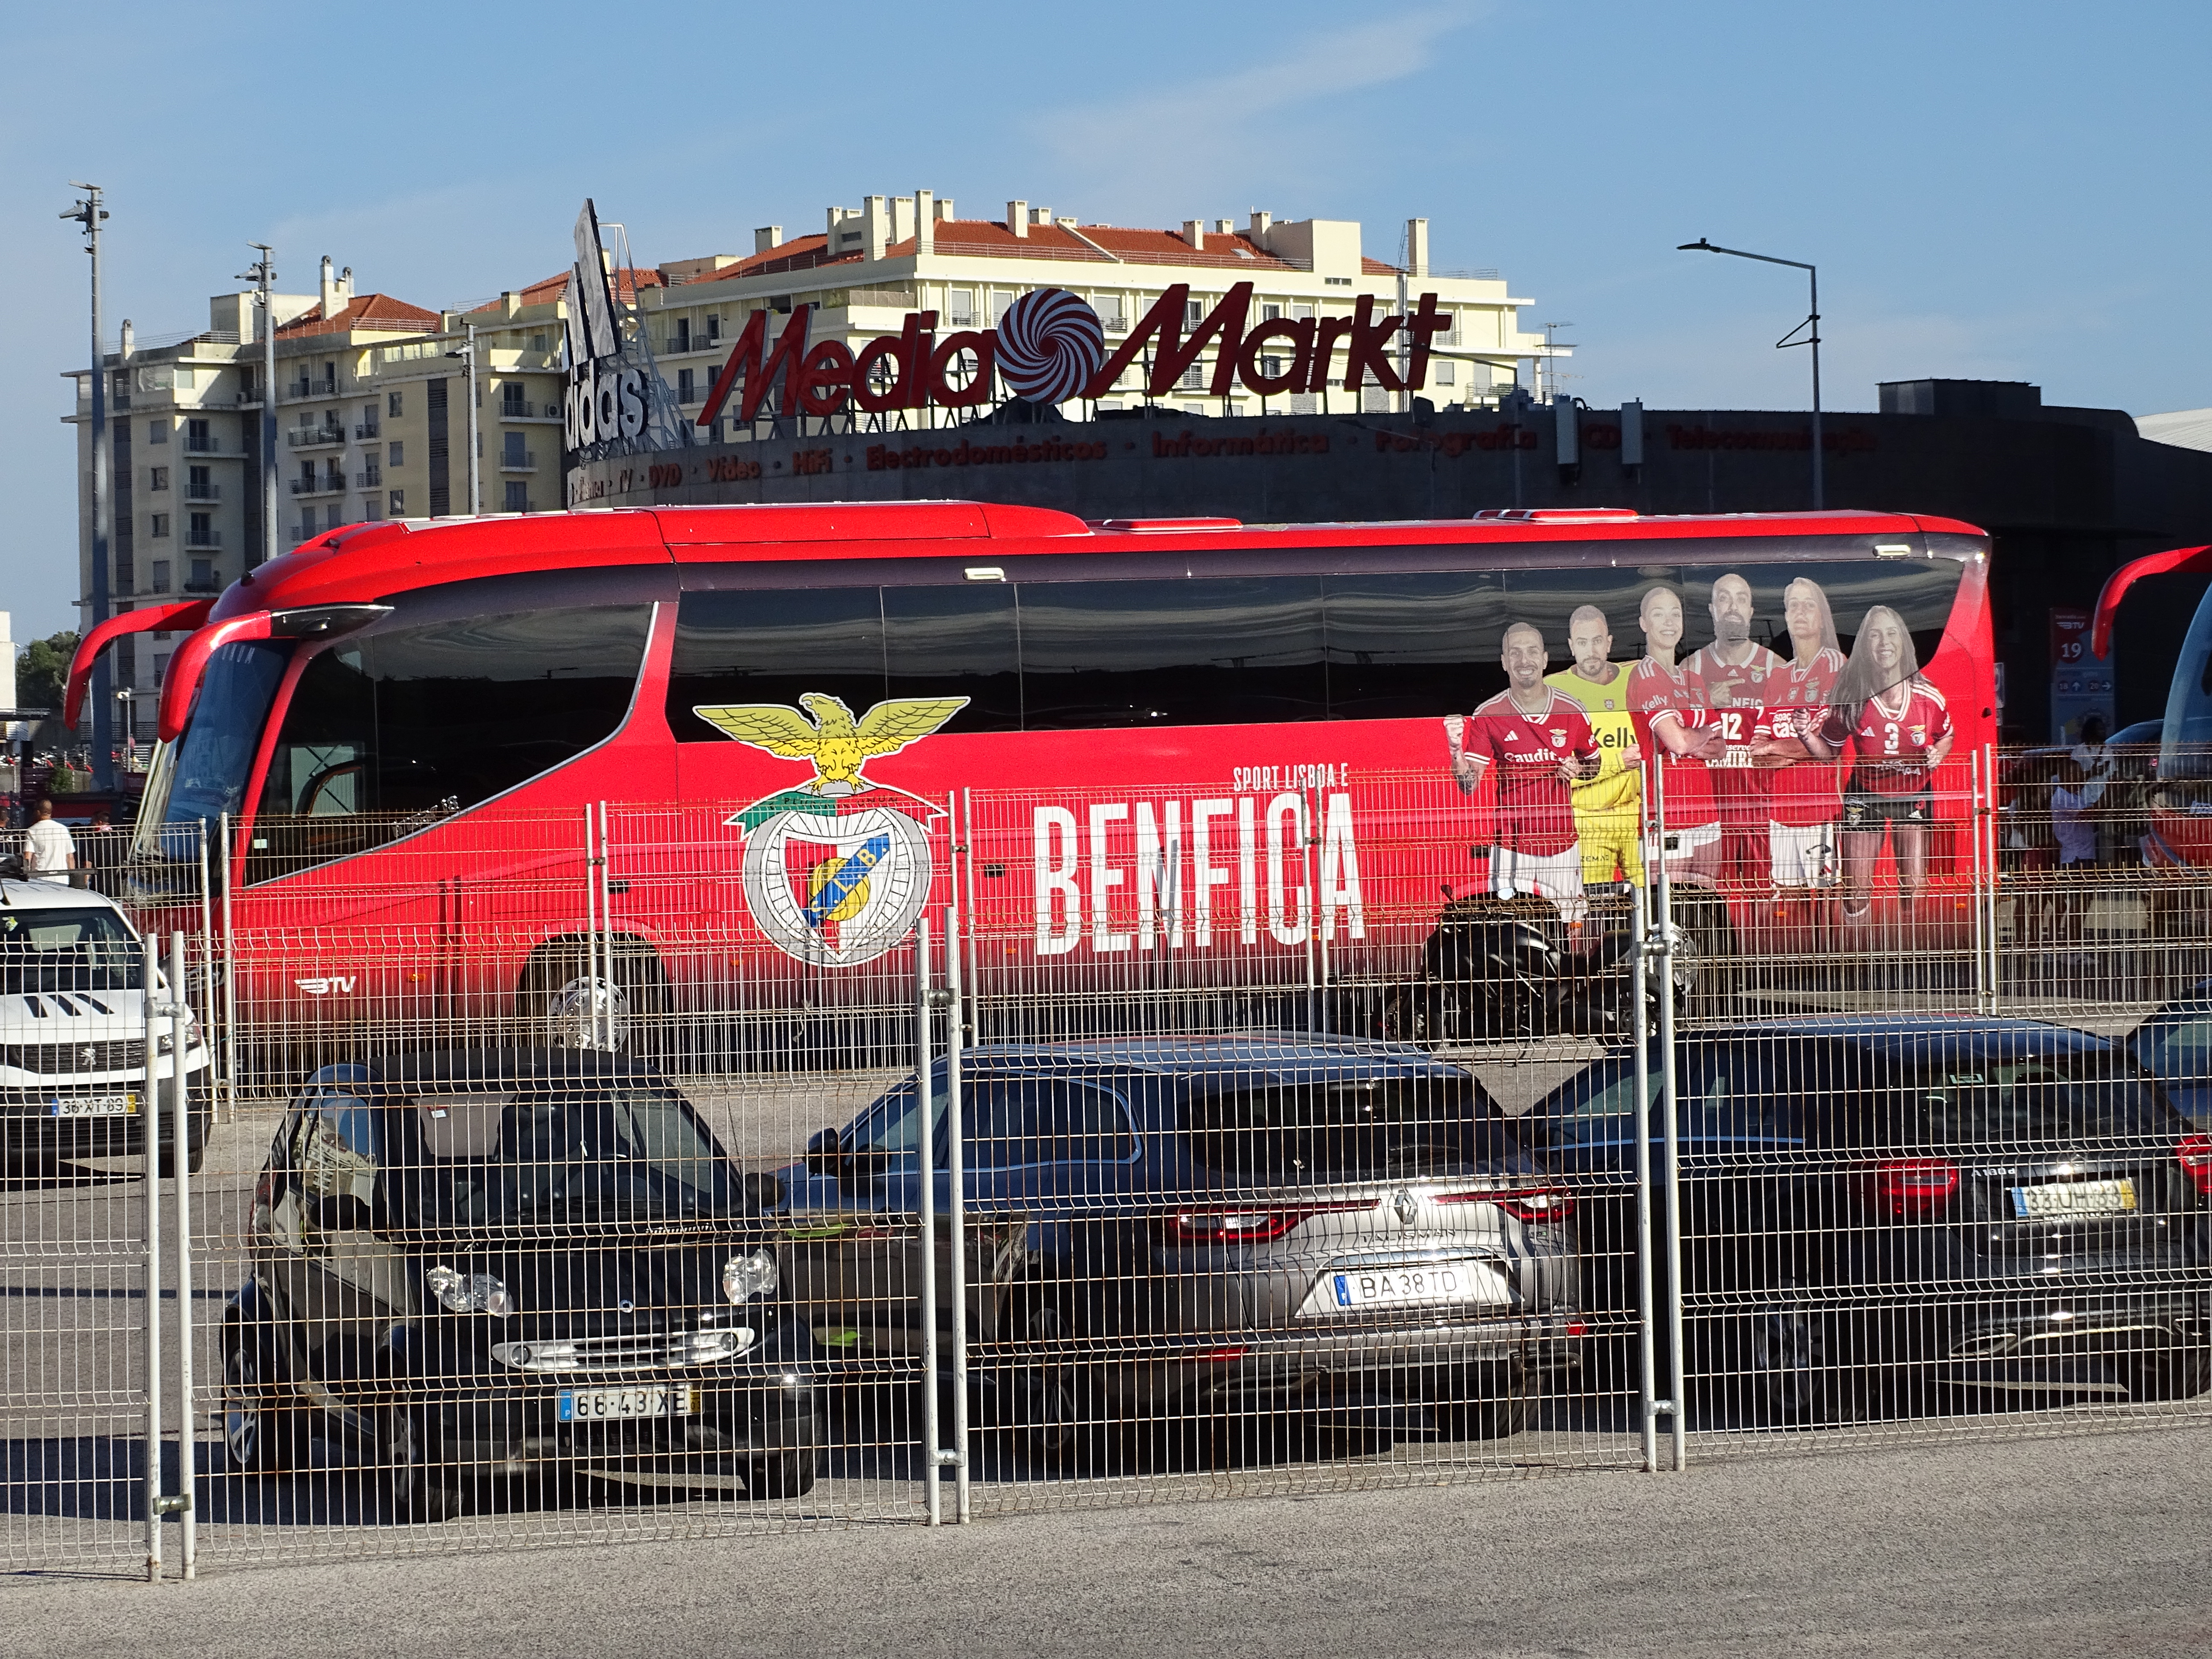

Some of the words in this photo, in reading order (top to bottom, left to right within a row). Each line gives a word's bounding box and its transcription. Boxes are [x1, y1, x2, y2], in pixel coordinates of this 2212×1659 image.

[696, 304, 999, 426] Media
[1080, 281, 1451, 400] Markt
[648, 463, 683, 489] DVD
[792, 448, 833, 475] HiFi
[866, 435, 1108, 471] Electrodomésticos
[1152, 428, 1330, 457] Informática
[2061, 643, 2081, 658] 19
[1642, 695, 1668, 715] Kelly
[1721, 713, 1742, 740] 12
[1885, 722, 1899, 750] 3
[1233, 766, 1266, 792] SPORT
[1285, 763, 1335, 789] LISBOA
[1341, 763, 1348, 787] E
[1034, 792, 1365, 956] BENFICA
[294, 976, 356, 994] BTV
[1360, 1228, 1456, 1243] TALISMAN
[1360, 1276, 1396, 1298] BA
[1399, 1273, 1425, 1295] 38
[1428, 1271, 1457, 1293] TD
